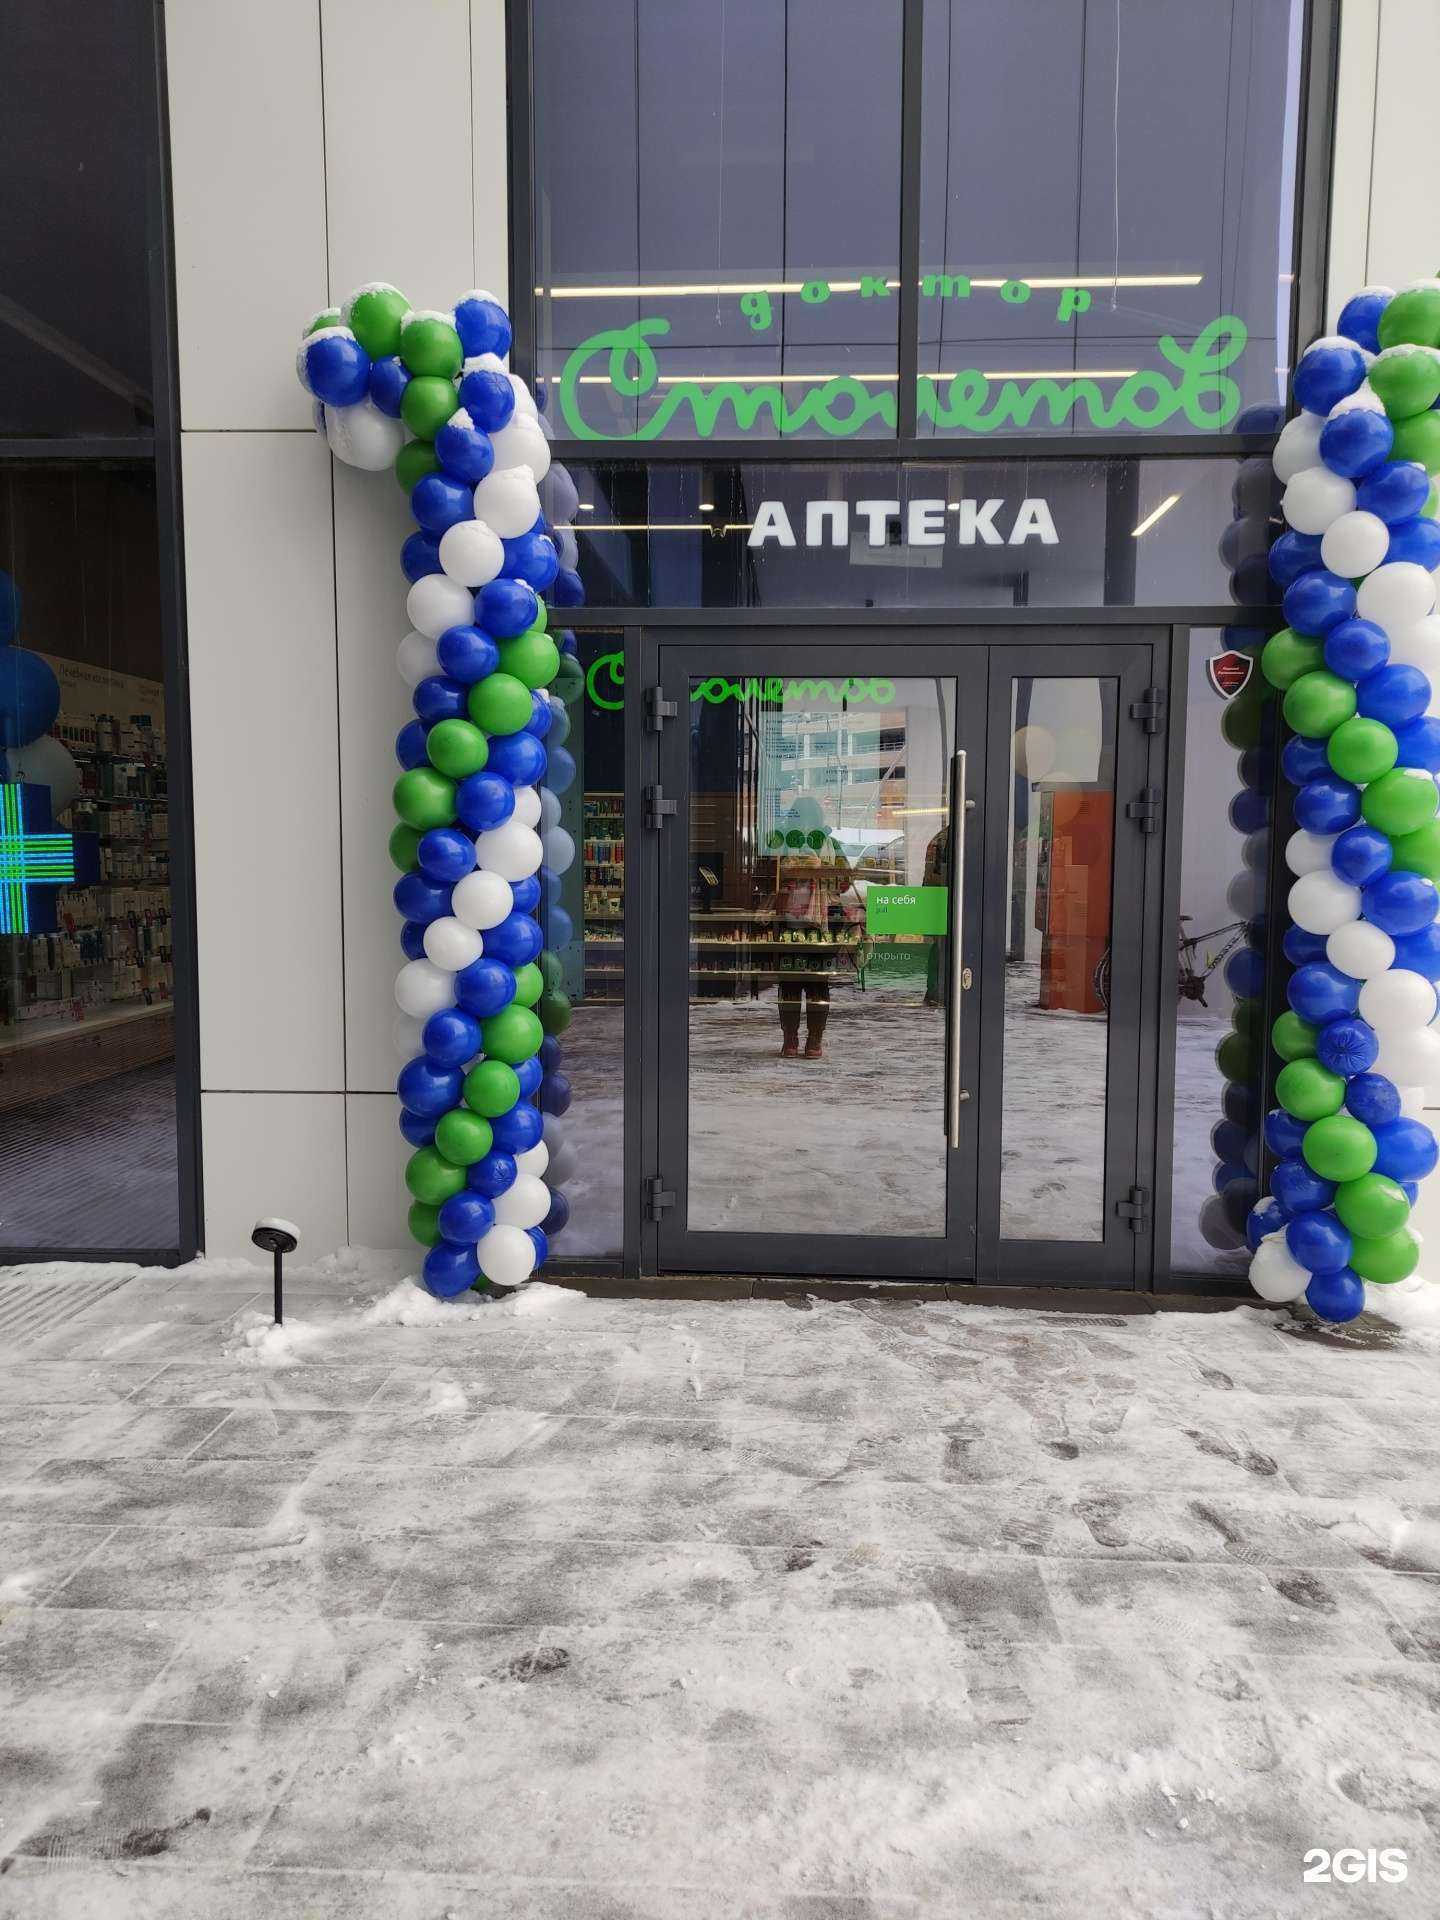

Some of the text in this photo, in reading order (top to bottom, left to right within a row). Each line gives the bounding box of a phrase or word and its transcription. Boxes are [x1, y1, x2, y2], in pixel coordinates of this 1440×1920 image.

[739, 274, 1092, 330] доктор
[746, 497, 1060, 548] АПТЕКА
[876, 894, 916, 905] на себя
